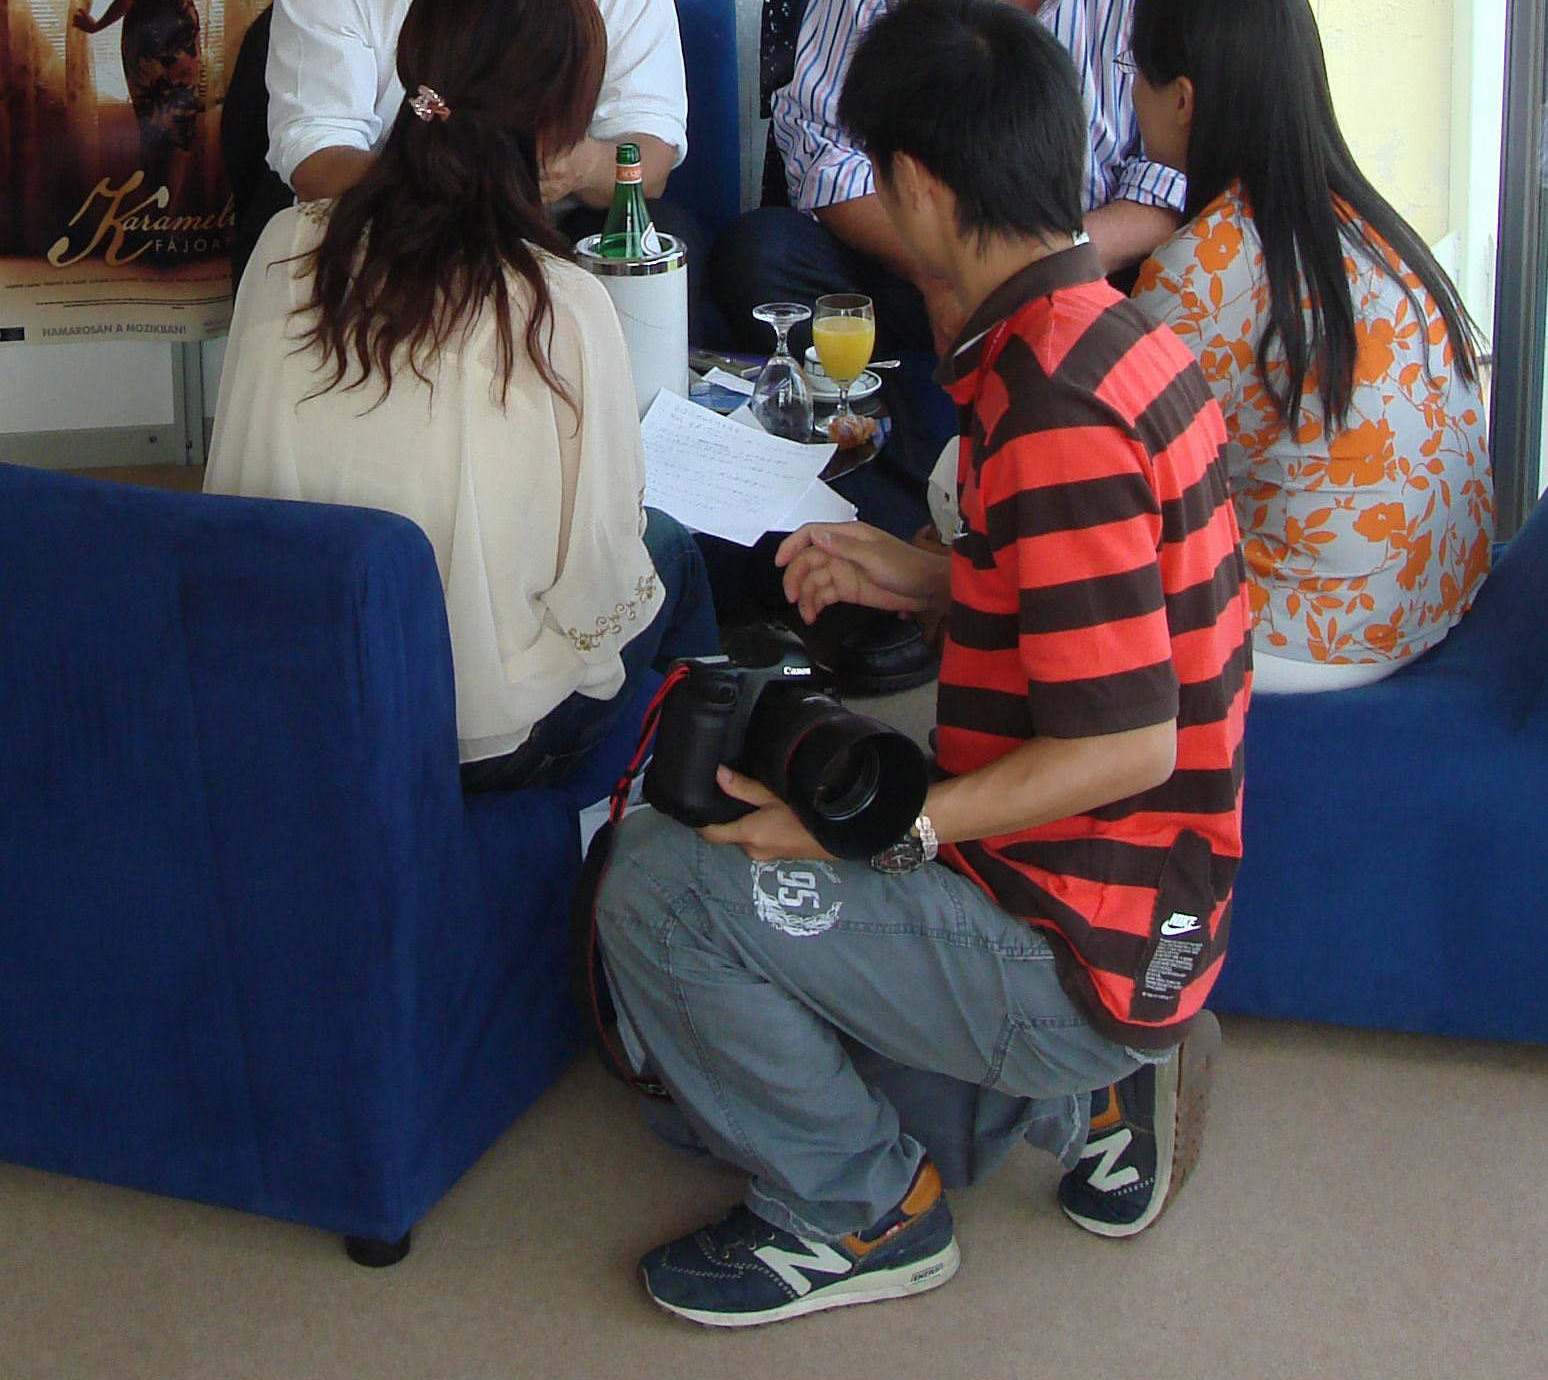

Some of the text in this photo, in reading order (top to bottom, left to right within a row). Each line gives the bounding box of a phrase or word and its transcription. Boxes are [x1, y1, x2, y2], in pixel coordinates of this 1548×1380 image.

[43, 324, 186, 337] HAMAROSAN A MOZIKBAN!
[783, 666, 811, 676] Canon
[1168, 912, 1198, 928] NIKE
[1084, 1129, 1139, 1191] N
[753, 1241, 852, 1296] N
